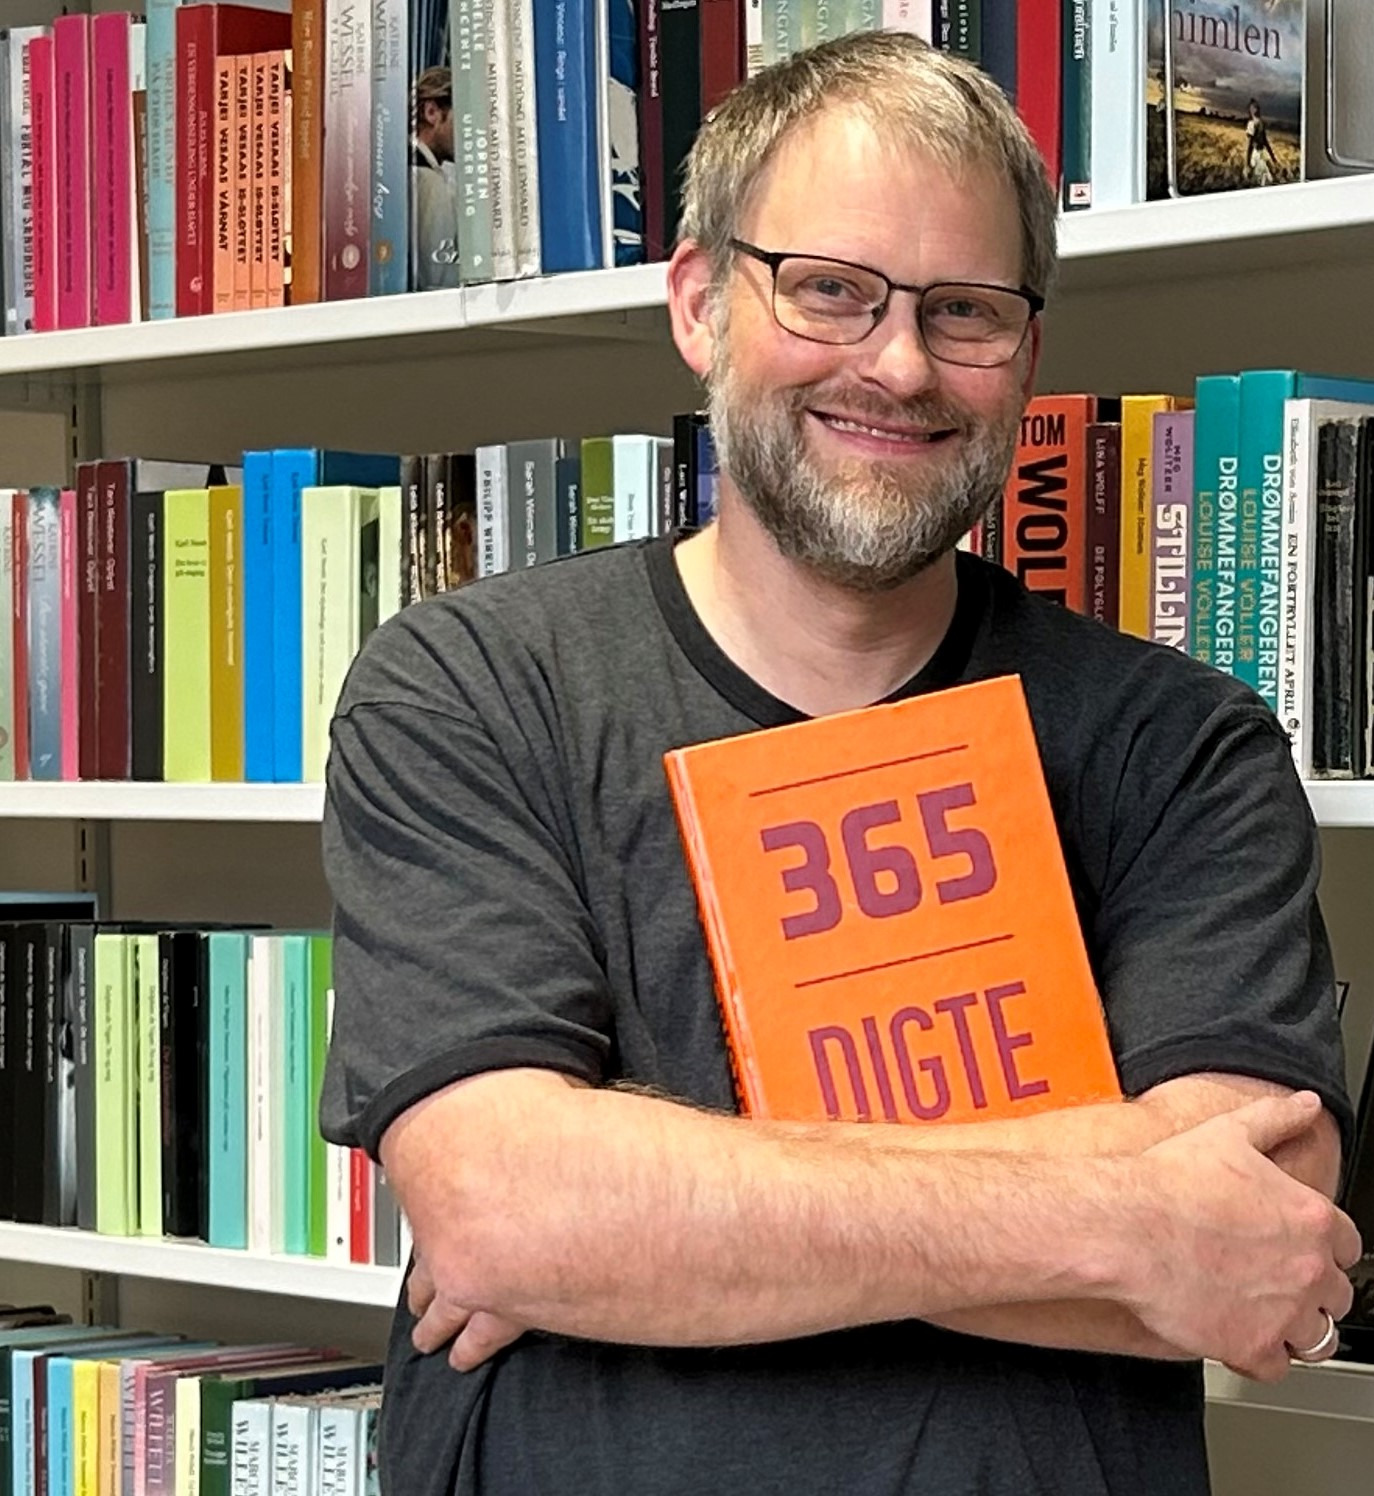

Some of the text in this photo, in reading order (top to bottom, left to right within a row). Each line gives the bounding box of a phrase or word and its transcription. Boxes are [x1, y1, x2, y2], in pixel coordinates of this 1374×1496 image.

[463, 114, 474, 216] UNDER MIG
[476, 129, 488, 200] JORDEN
[1021, 414, 1065, 446] TOM
[1095, 439, 1105, 468] LINA
[1095, 546, 1105, 564] DE
[1195, 491, 1212, 663] LOUISE VOLLER
[1238, 489, 1256, 662] LOUISE VOLLER
[1258, 455, 1281, 697] DRØMMEFANGEREN
[1286, 533, 1298, 557] EN
[1284, 668, 1297, 714] APRIL
[760, 782, 998, 941] 365
[808, 981, 1051, 1121] DIGTE
